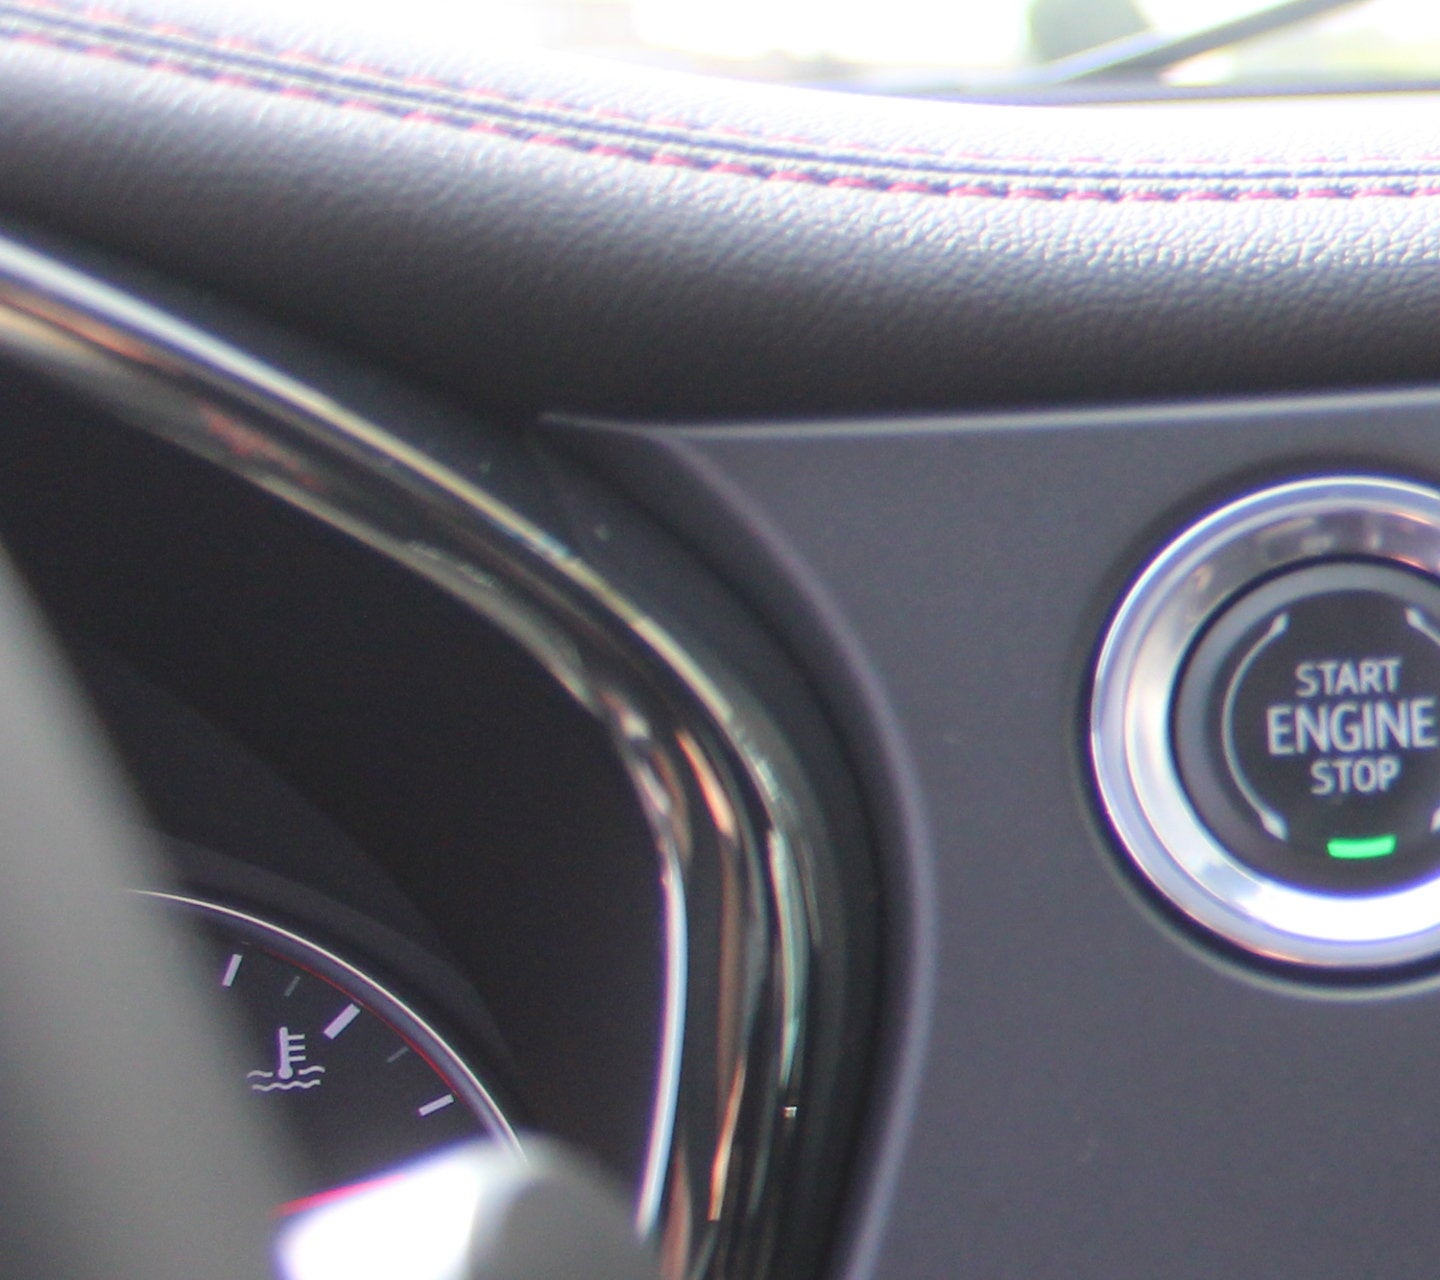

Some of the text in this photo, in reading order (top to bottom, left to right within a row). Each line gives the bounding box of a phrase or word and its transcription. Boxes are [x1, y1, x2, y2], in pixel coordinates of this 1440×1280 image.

[1295, 656, 1401, 698] START
[1266, 697, 1439, 756] ENGINE
[1310, 759, 1400, 796] STOP
